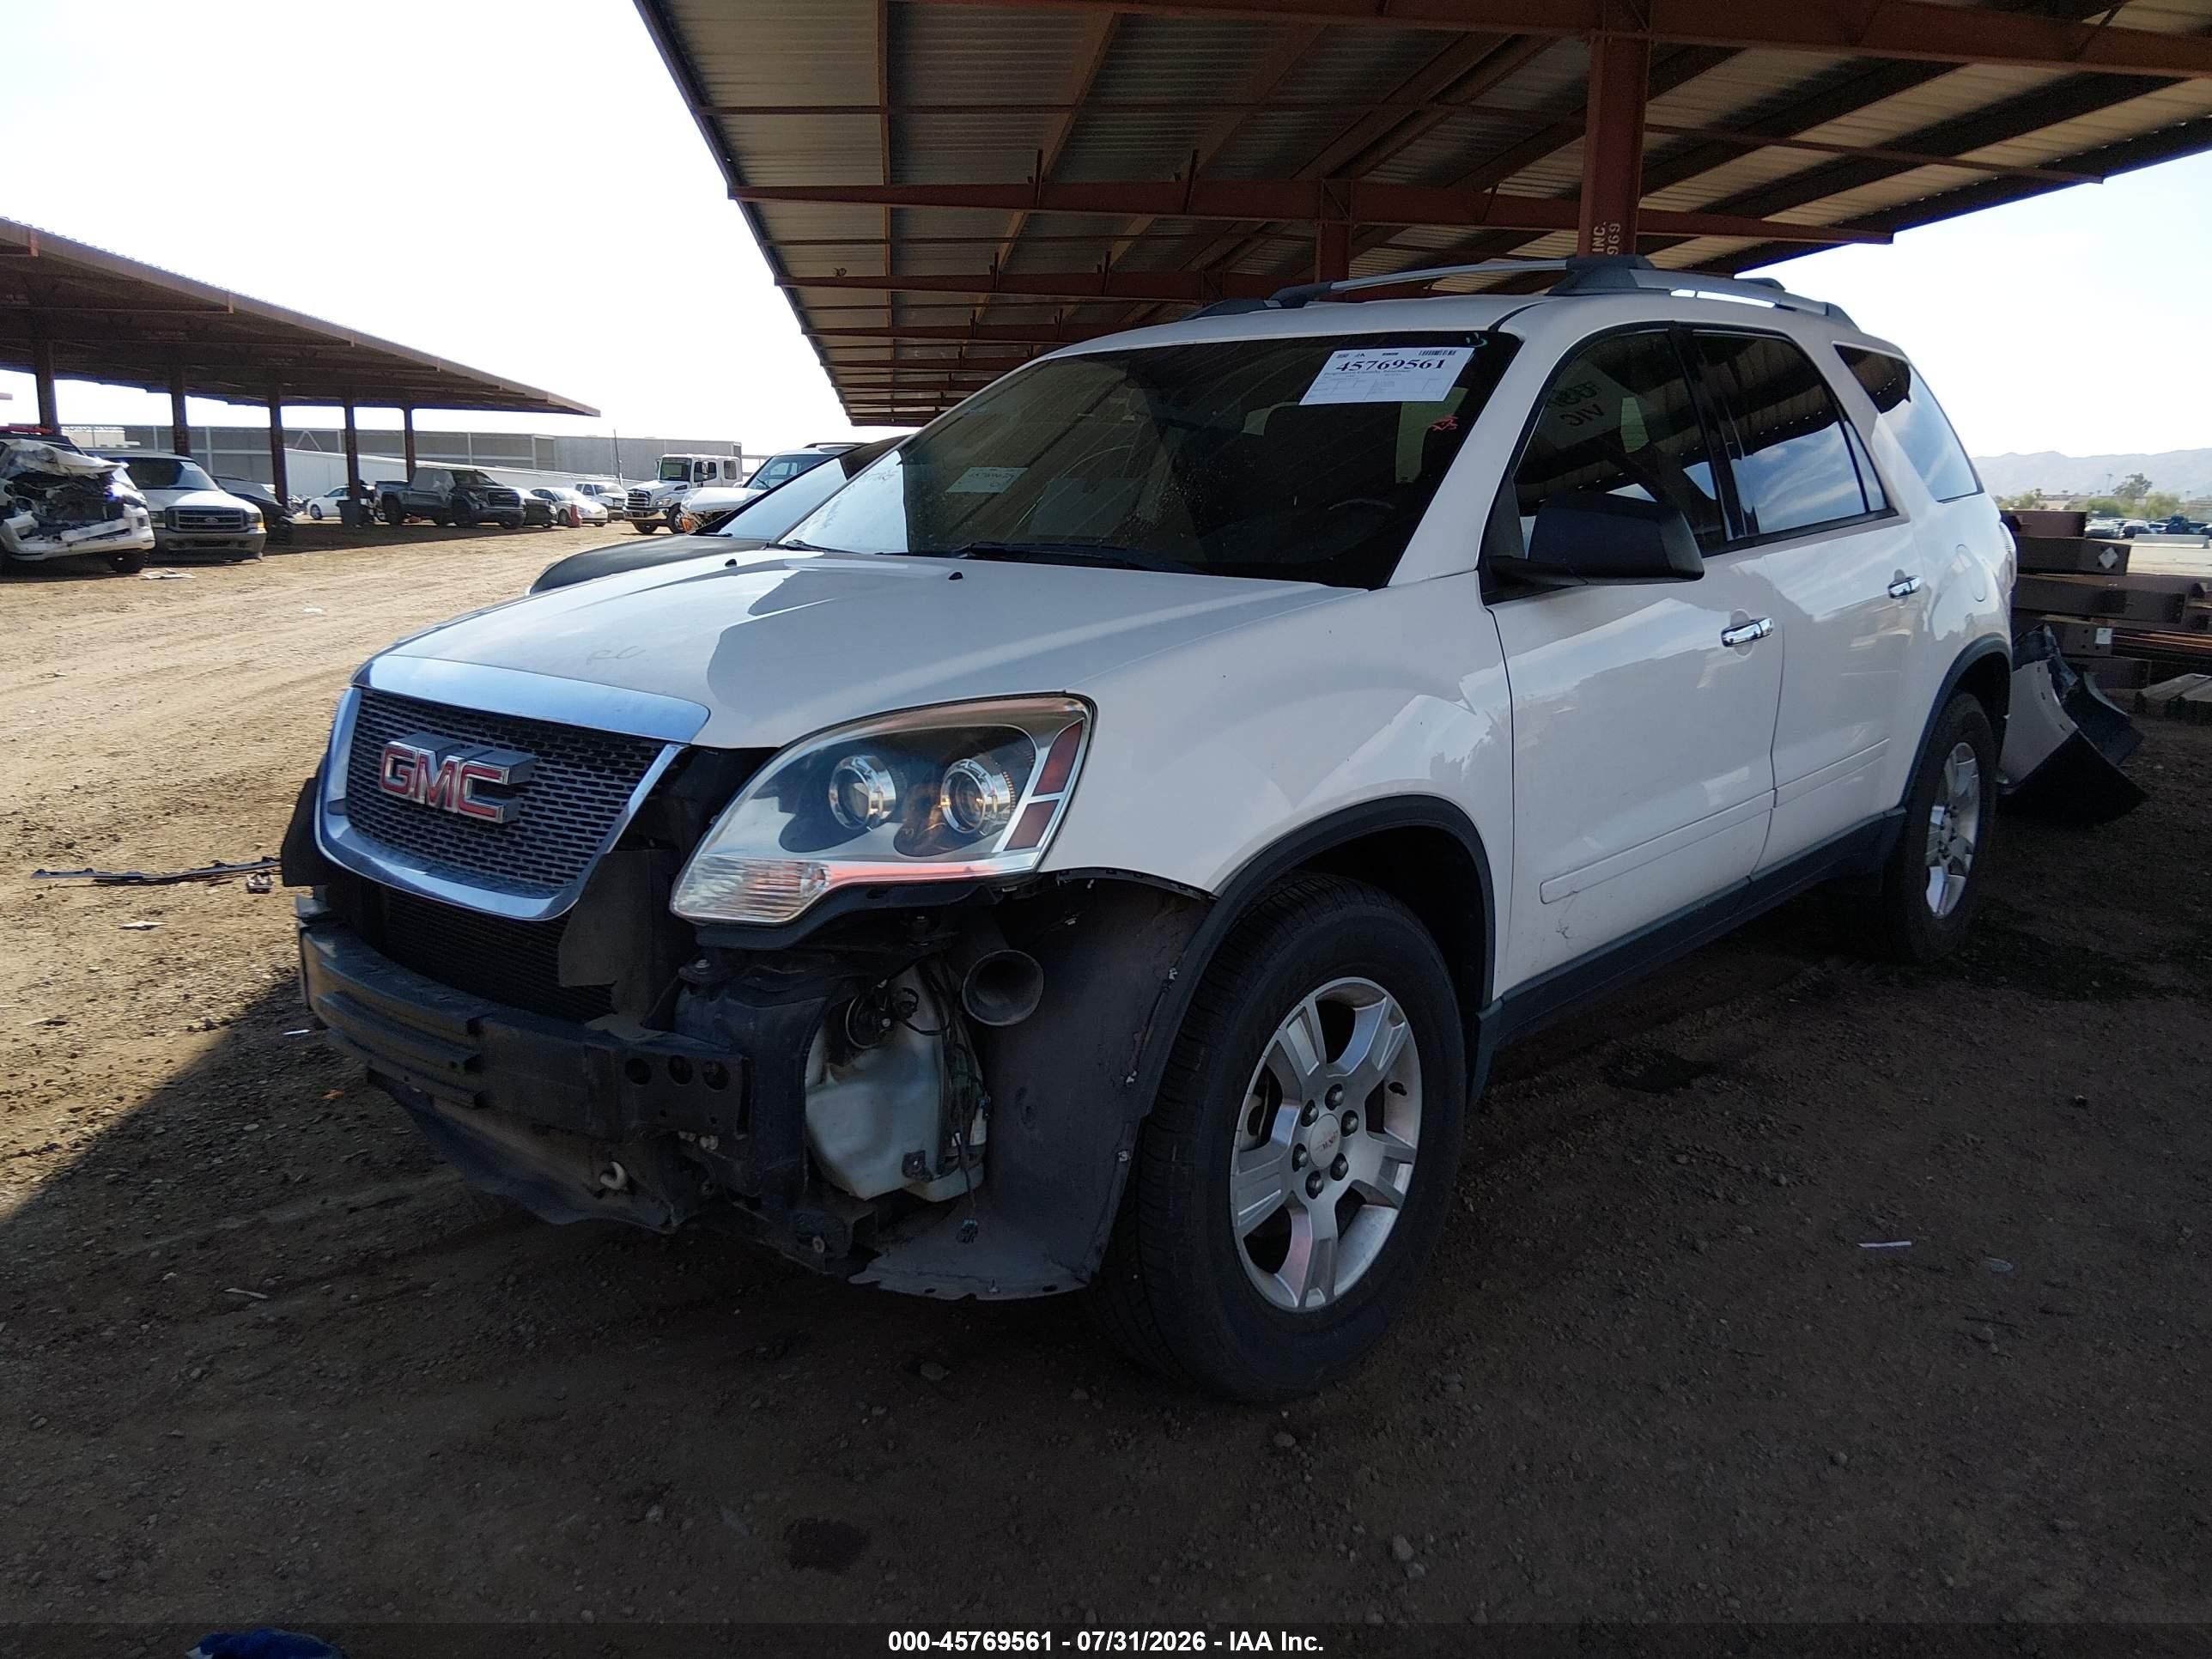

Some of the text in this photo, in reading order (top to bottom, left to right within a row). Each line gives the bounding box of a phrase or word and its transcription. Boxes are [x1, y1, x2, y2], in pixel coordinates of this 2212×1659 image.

[1591, 221, 1607, 253] INC.
[1606, 222, 1621, 255] 969
[1335, 358, 1447, 372] 45769561
[379, 739, 510, 824] GMC
